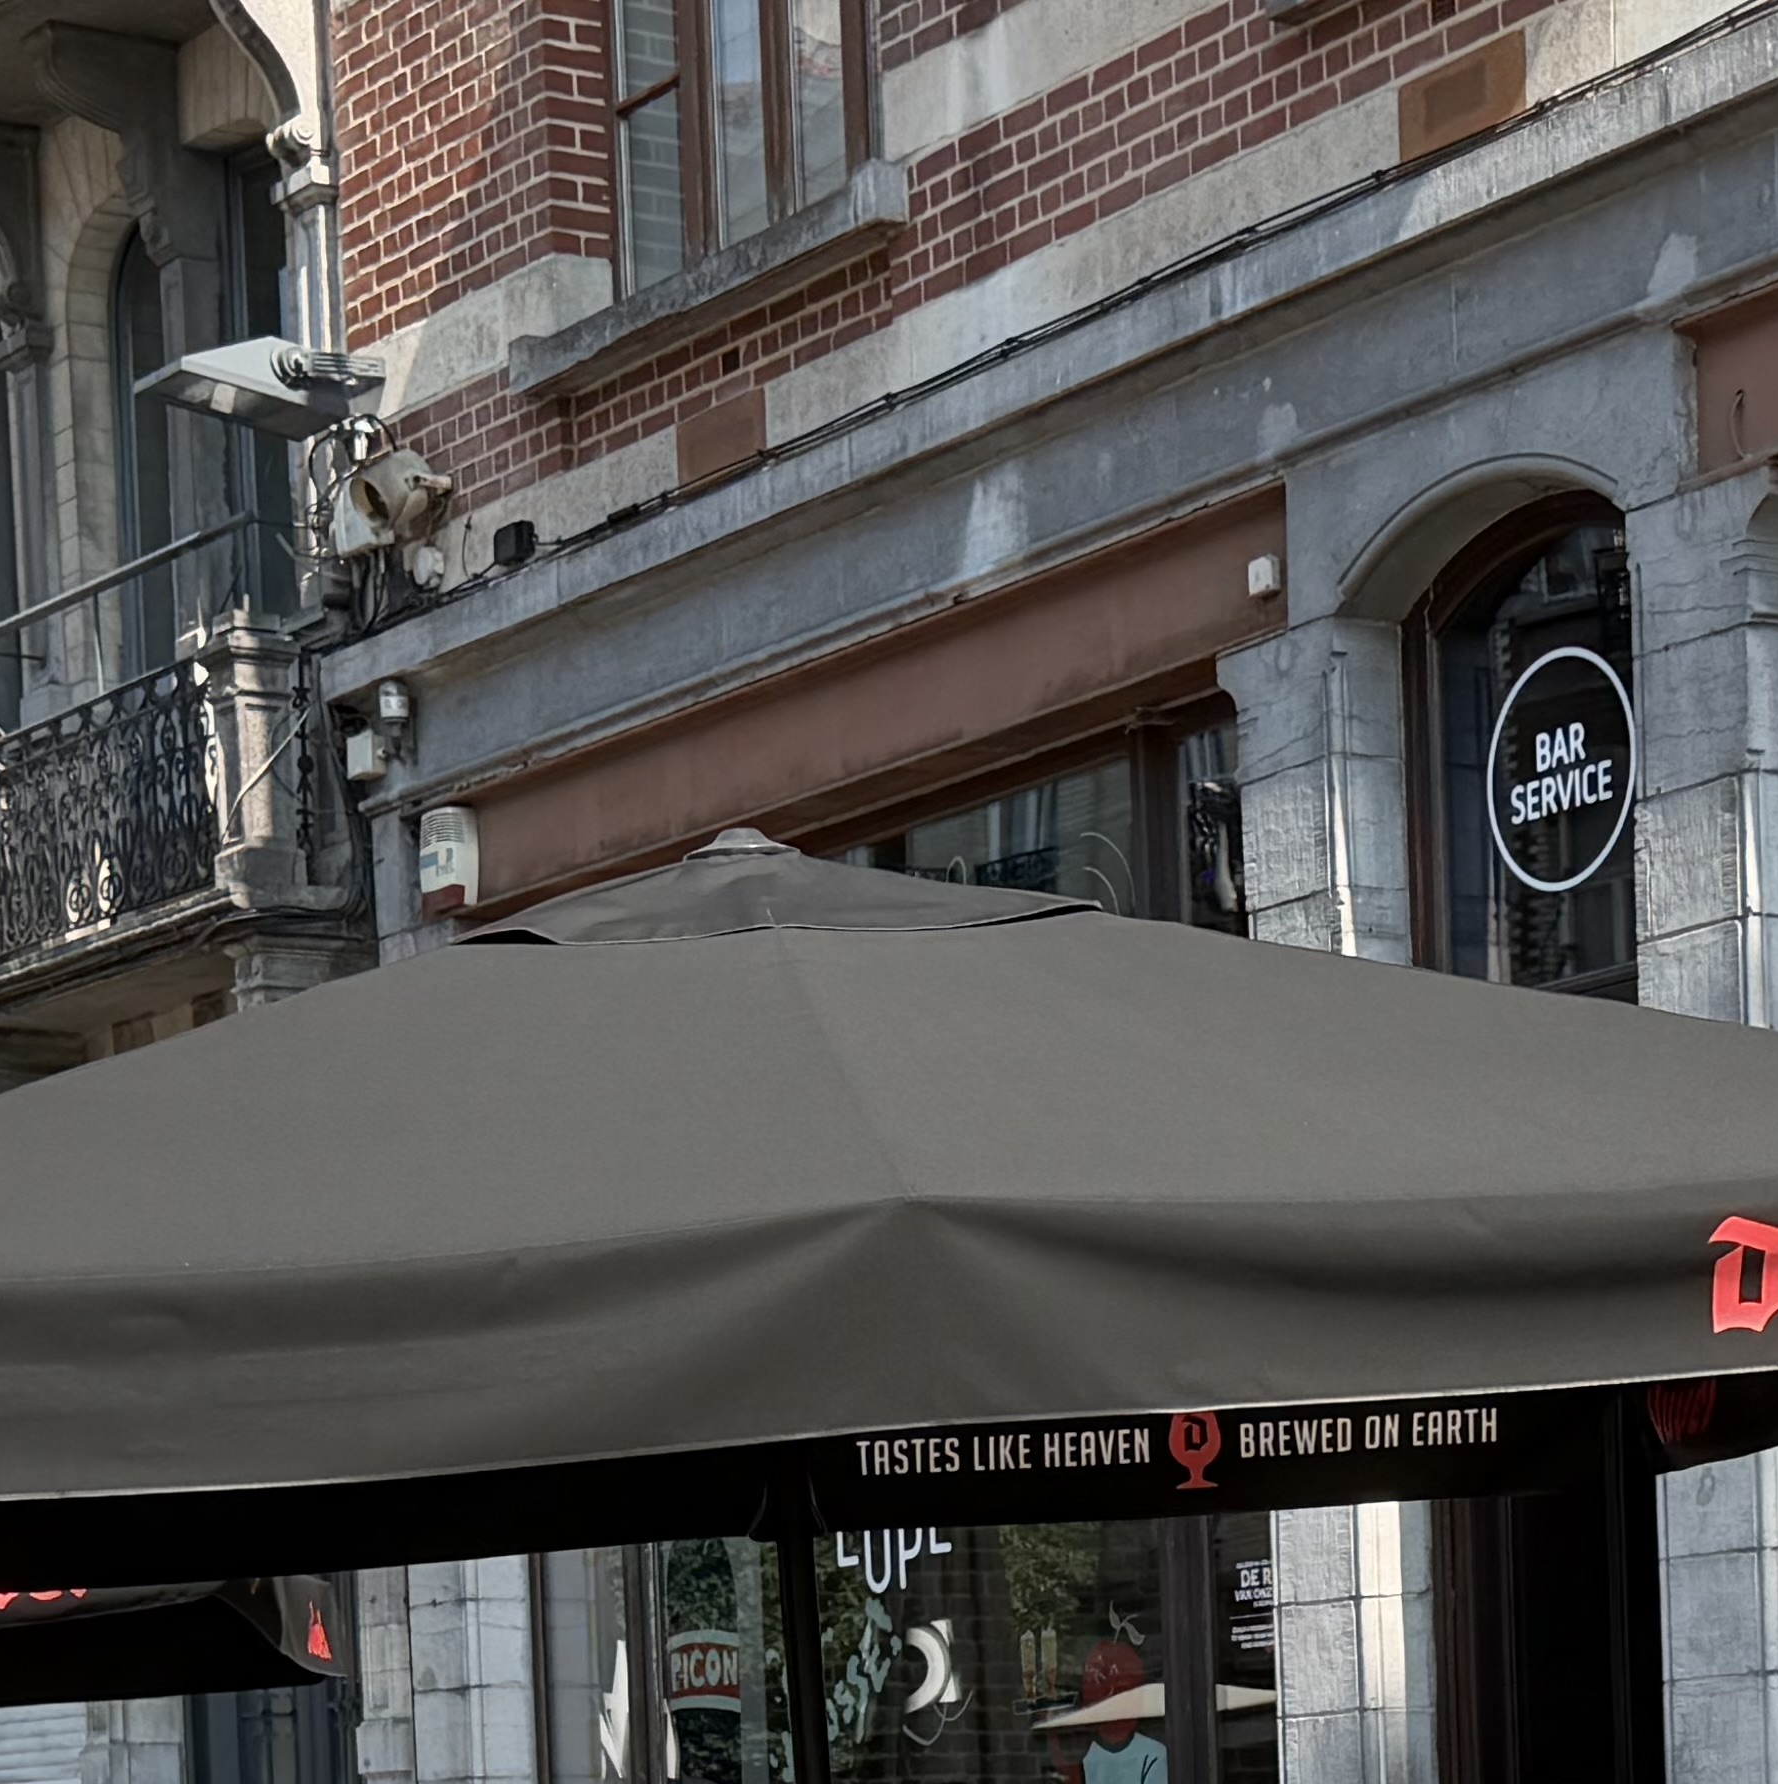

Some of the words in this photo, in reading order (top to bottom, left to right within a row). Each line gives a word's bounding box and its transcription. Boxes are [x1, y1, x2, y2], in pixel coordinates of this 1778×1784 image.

[1535, 722, 1586, 773] BAR
[1511, 759, 1614, 825] SERVICE
[856, 1434, 960, 1476] TASTES
[973, 1431, 1033, 1472] LIKE
[1044, 1428, 1151, 1468] HEAVEN
[1240, 1416, 1353, 1458] BREWED
[1365, 1413, 1399, 1449] ON
[1412, 1407, 1499, 1446] EARTH
[1240, 1569, 1260, 1588] DE
[1252, 1587, 1273, 1600] ONZ
[670, 1648, 739, 1691] PICON
